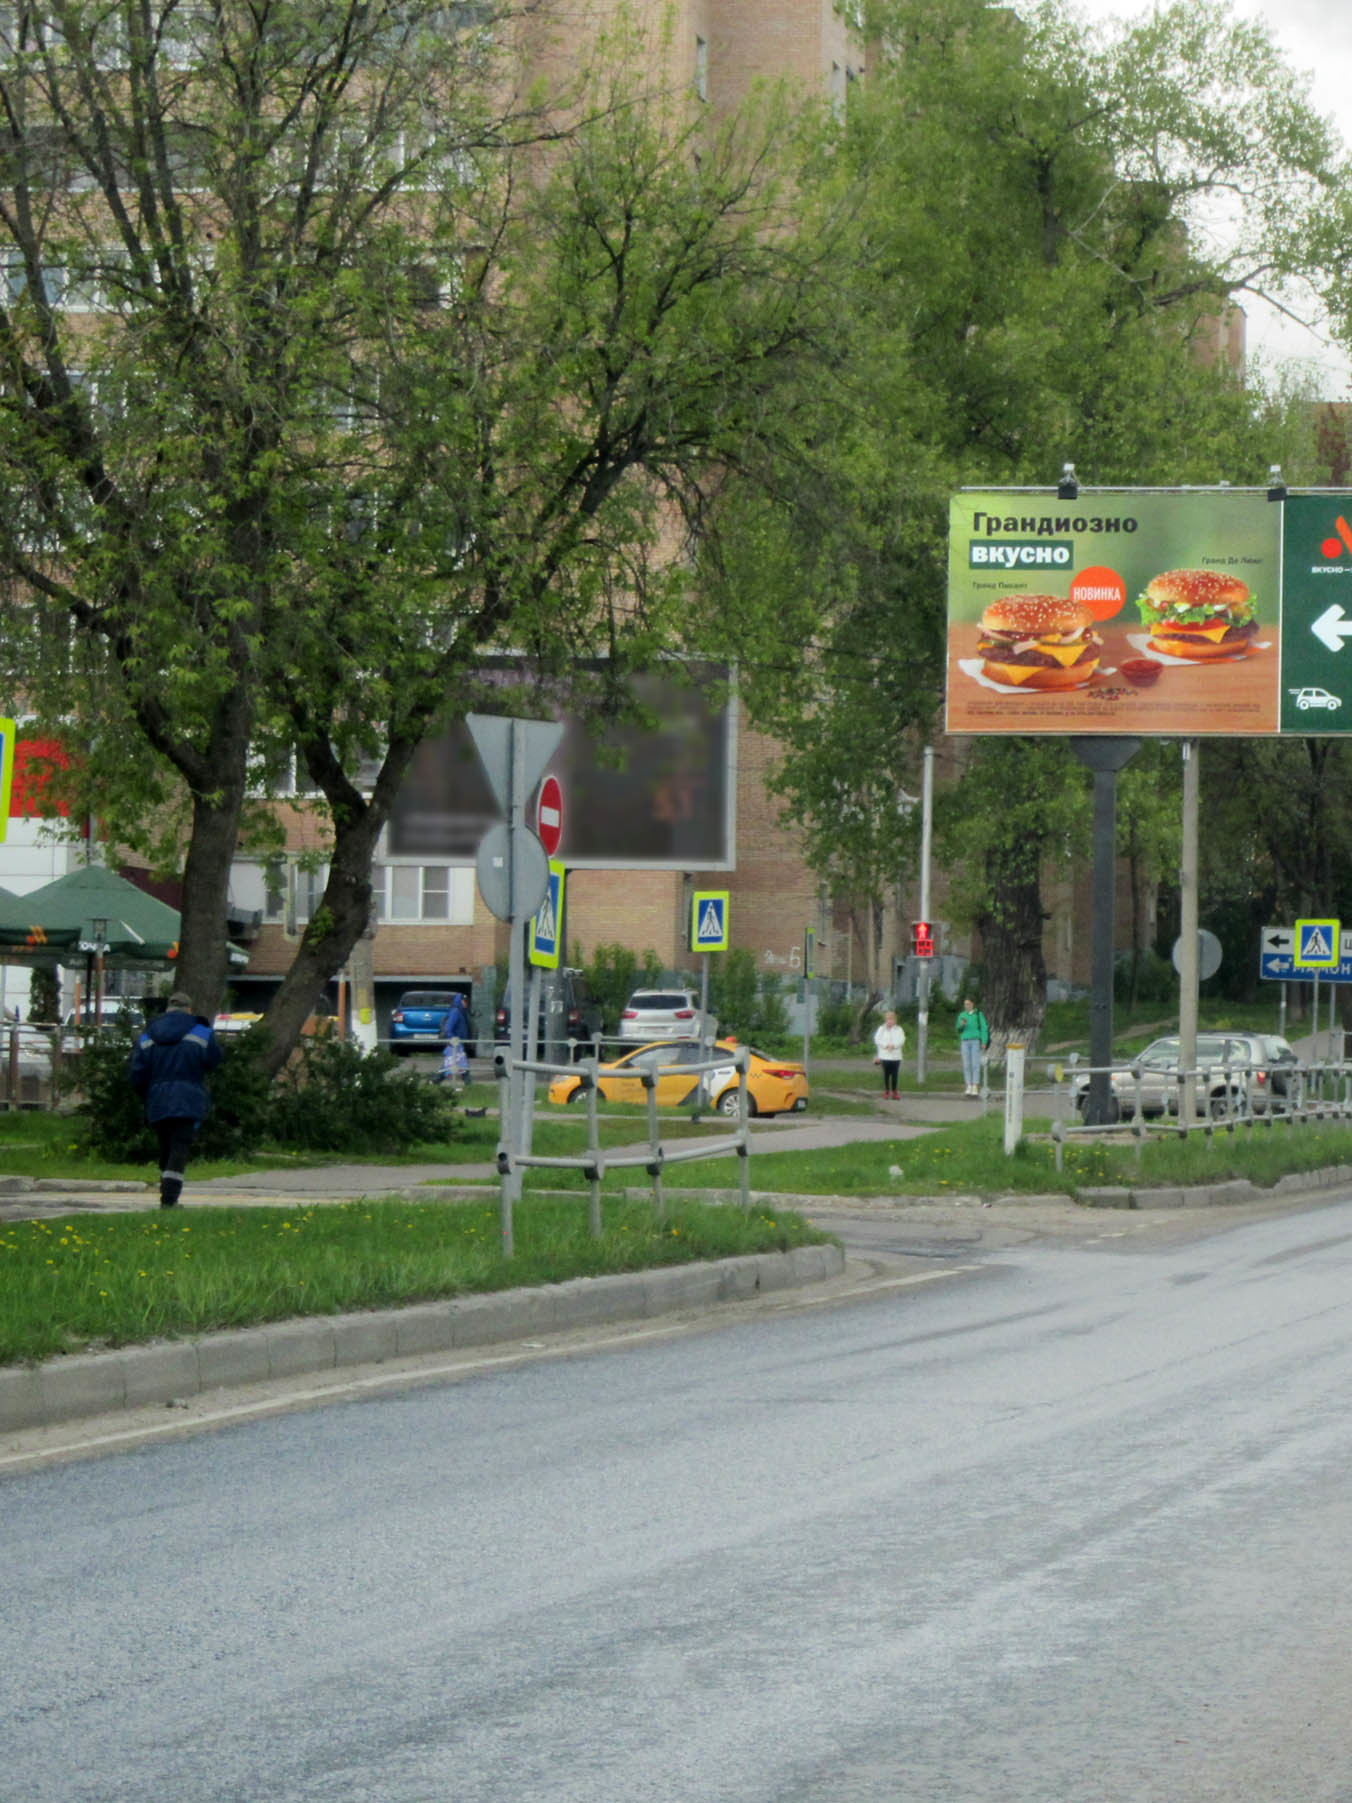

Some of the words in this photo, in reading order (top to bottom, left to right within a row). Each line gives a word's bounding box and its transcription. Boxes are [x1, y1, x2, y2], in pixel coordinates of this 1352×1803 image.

[973, 512, 1138, 536] Грандиозно
[971, 546, 1070, 568] вкусно
[1312, 566, 1344, 574] ВКУСНО
[1073, 586, 1122, 601] НОВИНКА
